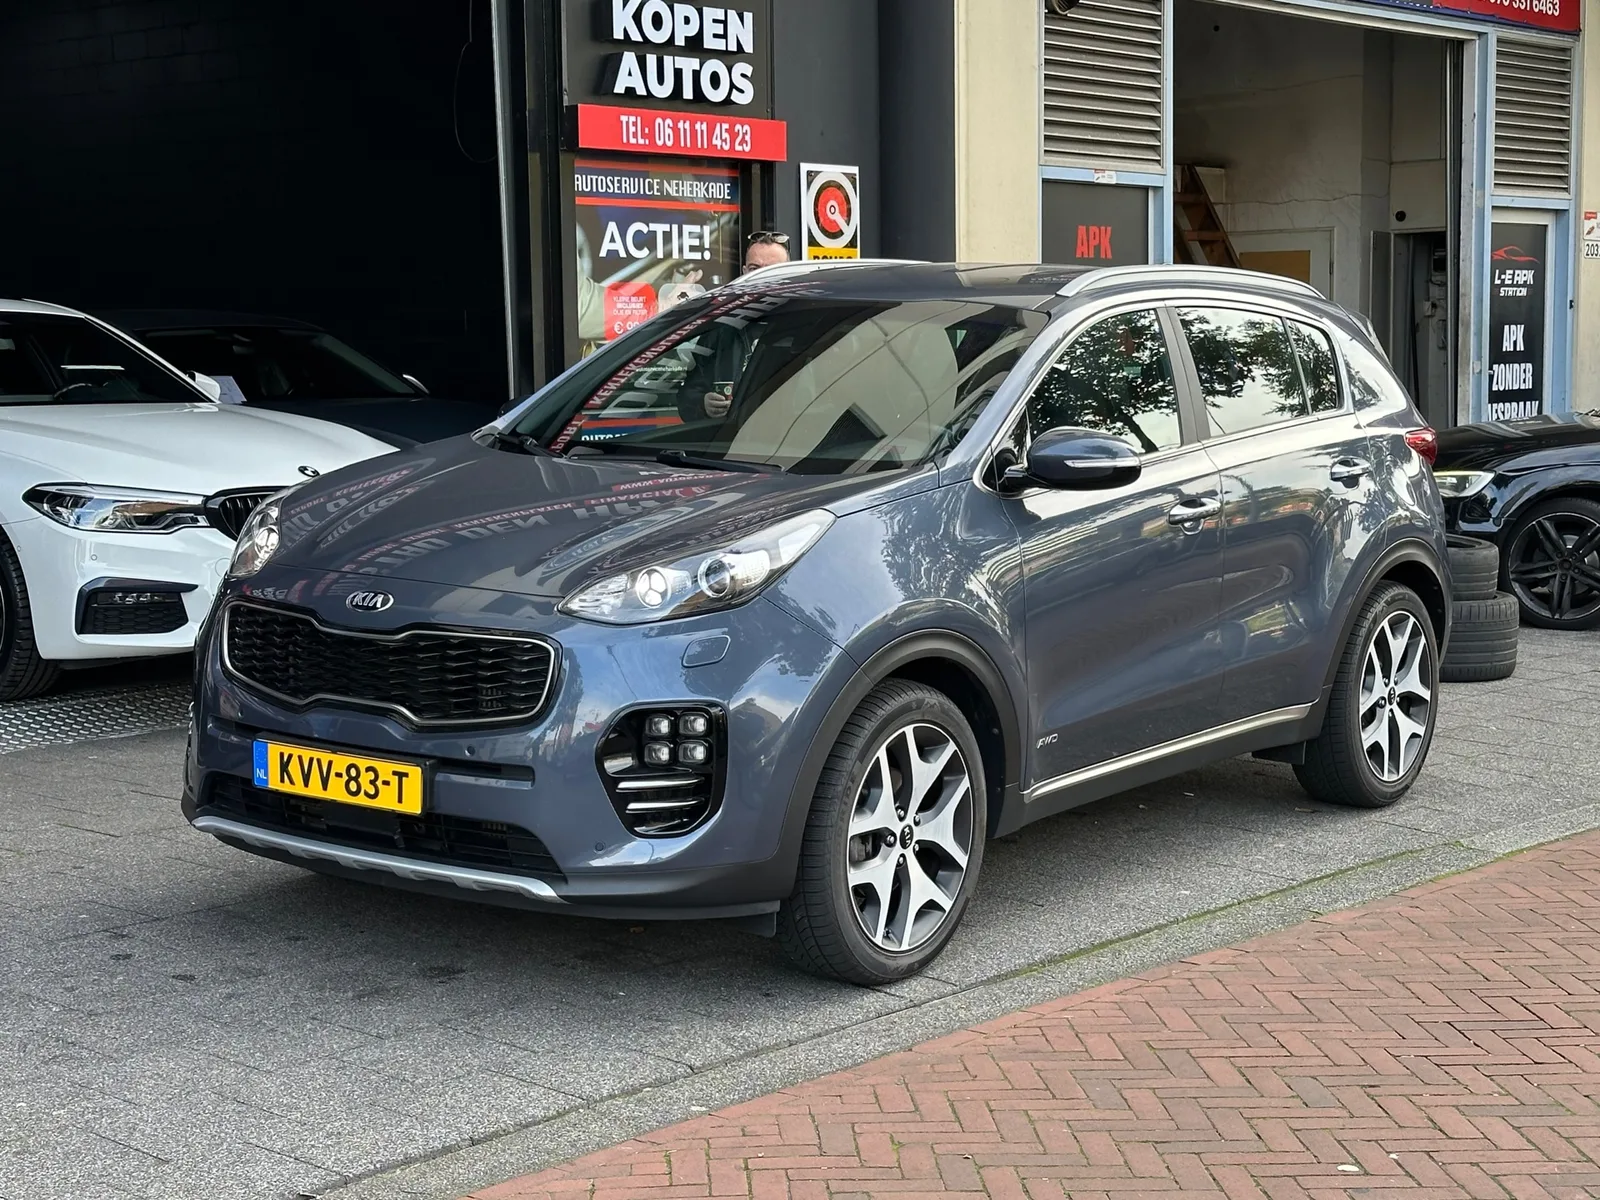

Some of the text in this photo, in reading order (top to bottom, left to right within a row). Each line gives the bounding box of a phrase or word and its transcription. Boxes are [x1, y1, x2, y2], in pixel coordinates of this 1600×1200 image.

[1532, 0, 1560, 17] 6463
[612, 0, 754, 53] KOPEN
[613, 51, 755, 105] AUTOS
[620, 114, 751, 153] TEL: 06 11 11 45 23
[574, 173, 731, 200] AUTOSERVICE NEHERKADE
[599, 221, 711, 261] ACTIE!
[1076, 225, 1113, 259] APK
[1585, 243, 1600, 257] 203
[1514, 269, 1535, 285] APK
[1499, 287, 1527, 297] STATION
[1502, 324, 1525, 351] APK
[1491, 362, 1533, 391] ZONDER
[351, 592, 387, 610] KIA
[256, 751, 410, 804] NL KVV-83-T
[903, 827, 911, 847] KIA
